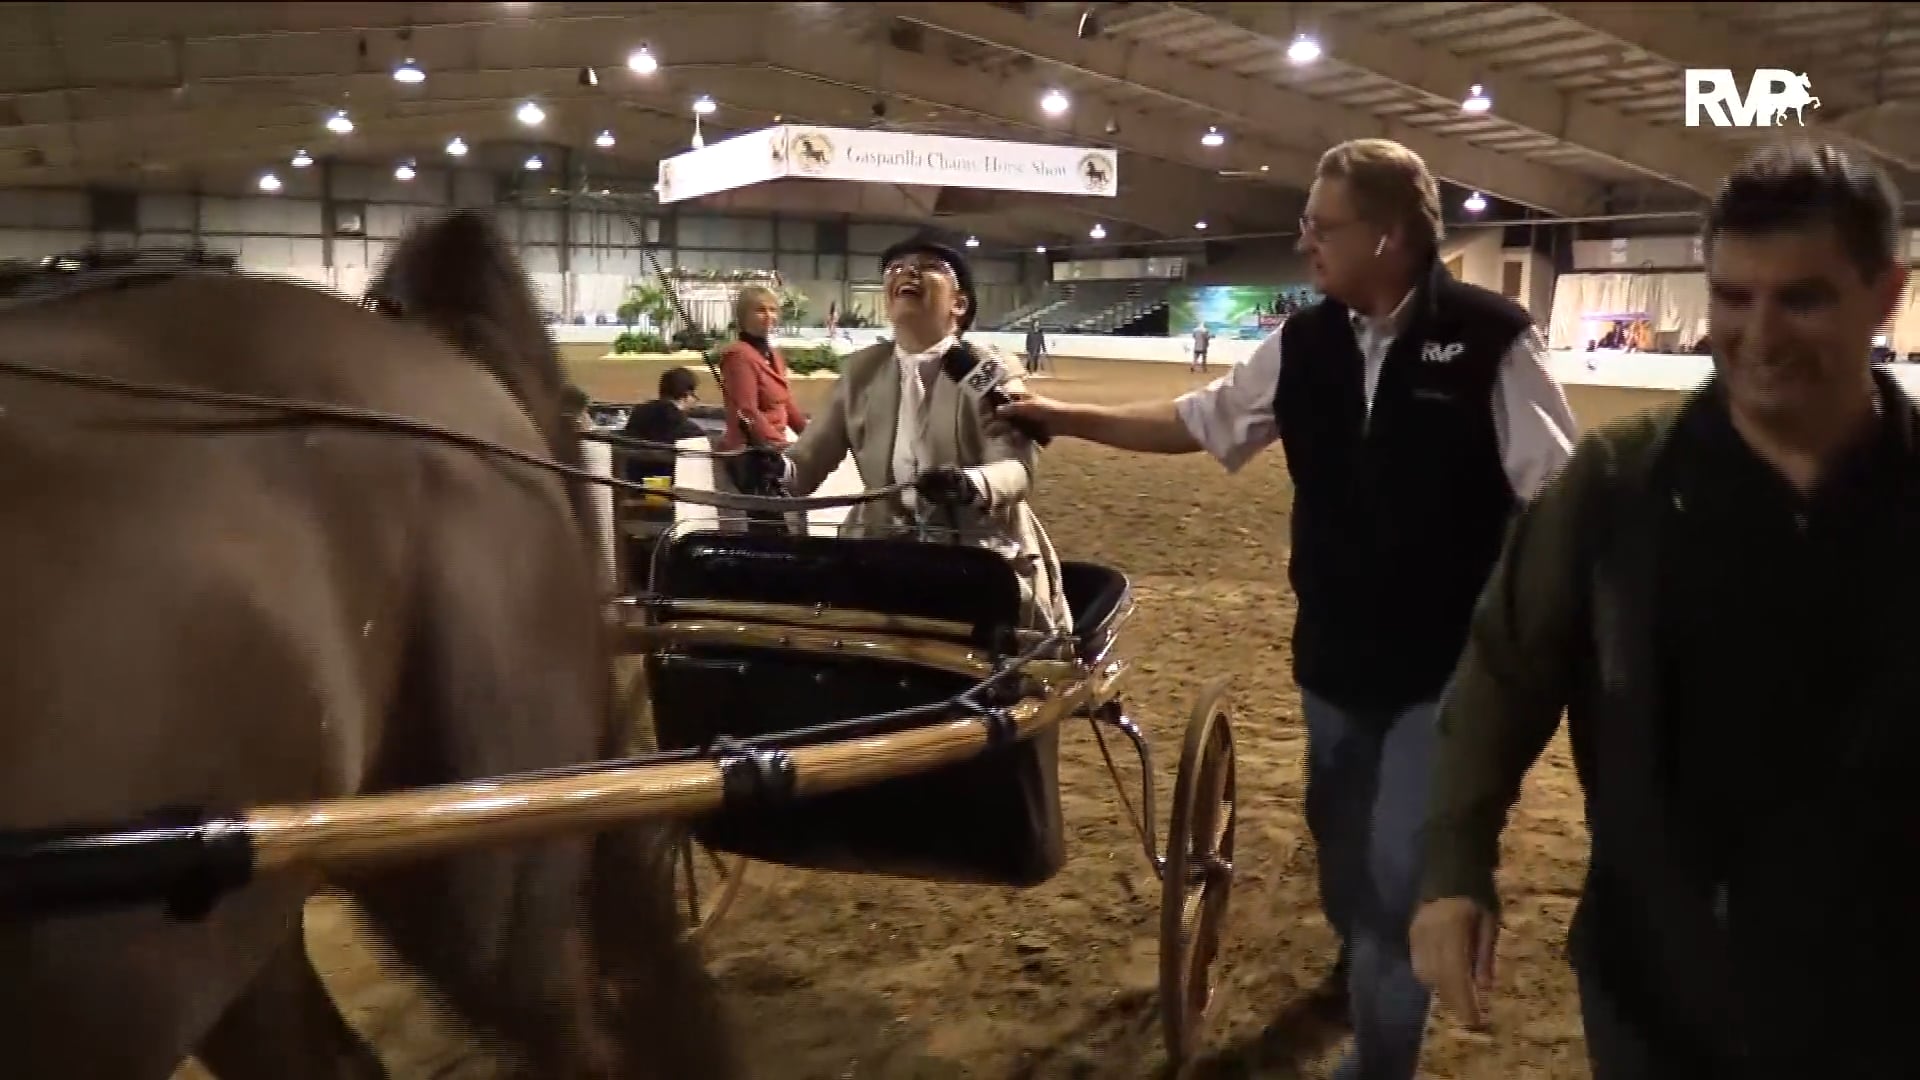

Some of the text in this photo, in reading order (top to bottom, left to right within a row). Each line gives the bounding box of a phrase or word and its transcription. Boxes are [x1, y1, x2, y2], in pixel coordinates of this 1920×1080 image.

[846, 147, 922, 166] Gasparilla
[985, 156, 1024, 173] Horse
[1032, 161, 1067, 176] Show
[1421, 342, 1465, 362] RVP
